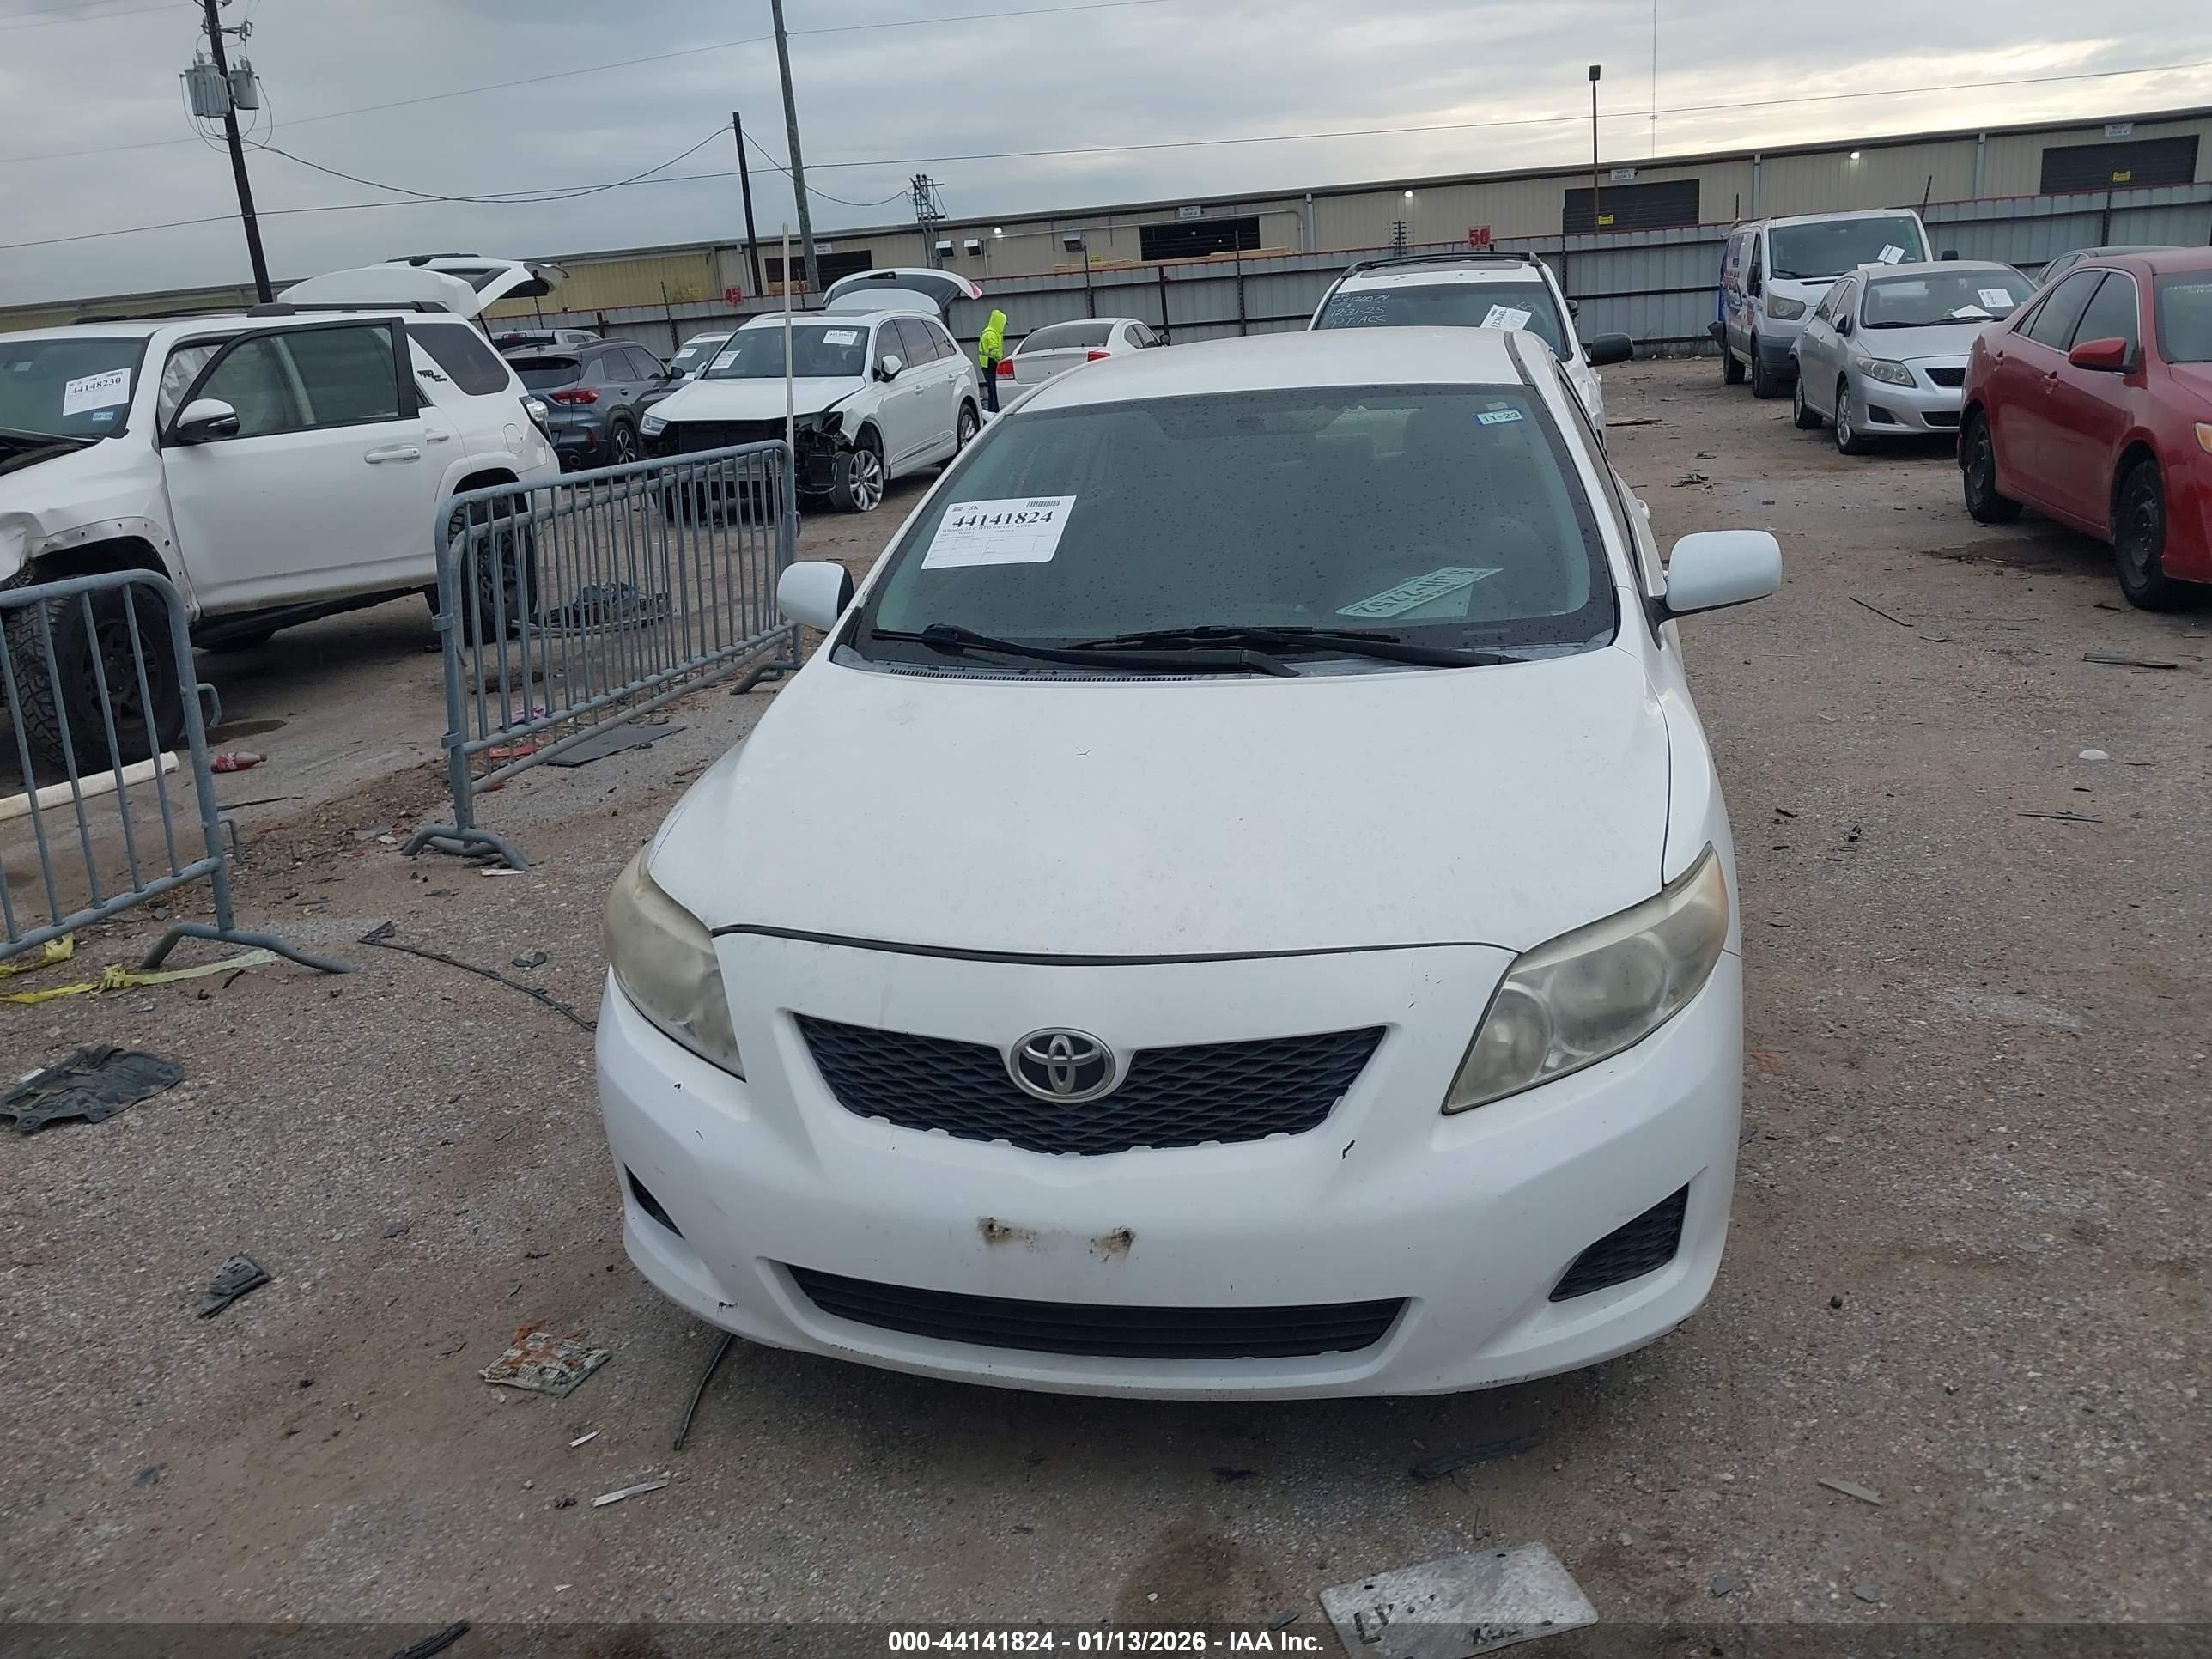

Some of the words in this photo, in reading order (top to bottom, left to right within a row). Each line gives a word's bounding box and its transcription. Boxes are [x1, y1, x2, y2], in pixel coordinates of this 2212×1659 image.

[726, 288, 741, 301] 45
[70, 377, 122, 394] 44148230
[952, 510, 1054, 528] 44141824
